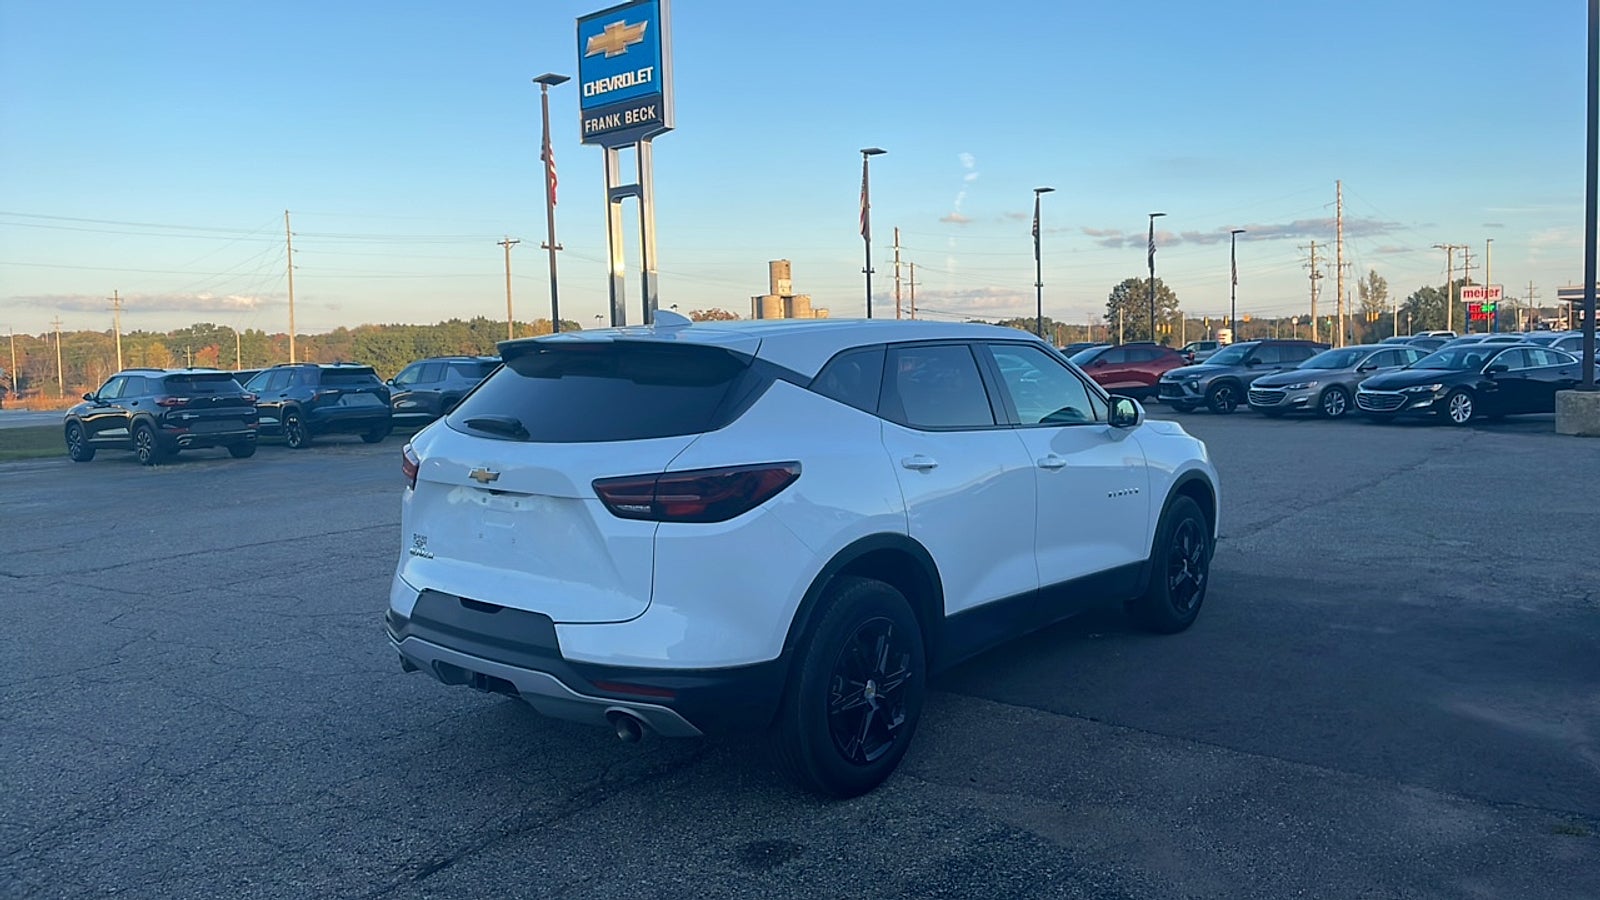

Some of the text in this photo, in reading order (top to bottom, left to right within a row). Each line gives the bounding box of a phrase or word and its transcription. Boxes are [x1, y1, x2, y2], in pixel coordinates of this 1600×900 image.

[583, 66, 654, 97] CHEVROLET
[585, 105, 656, 133] FRANK BECK
[1463, 287, 1500, 300] meijer
